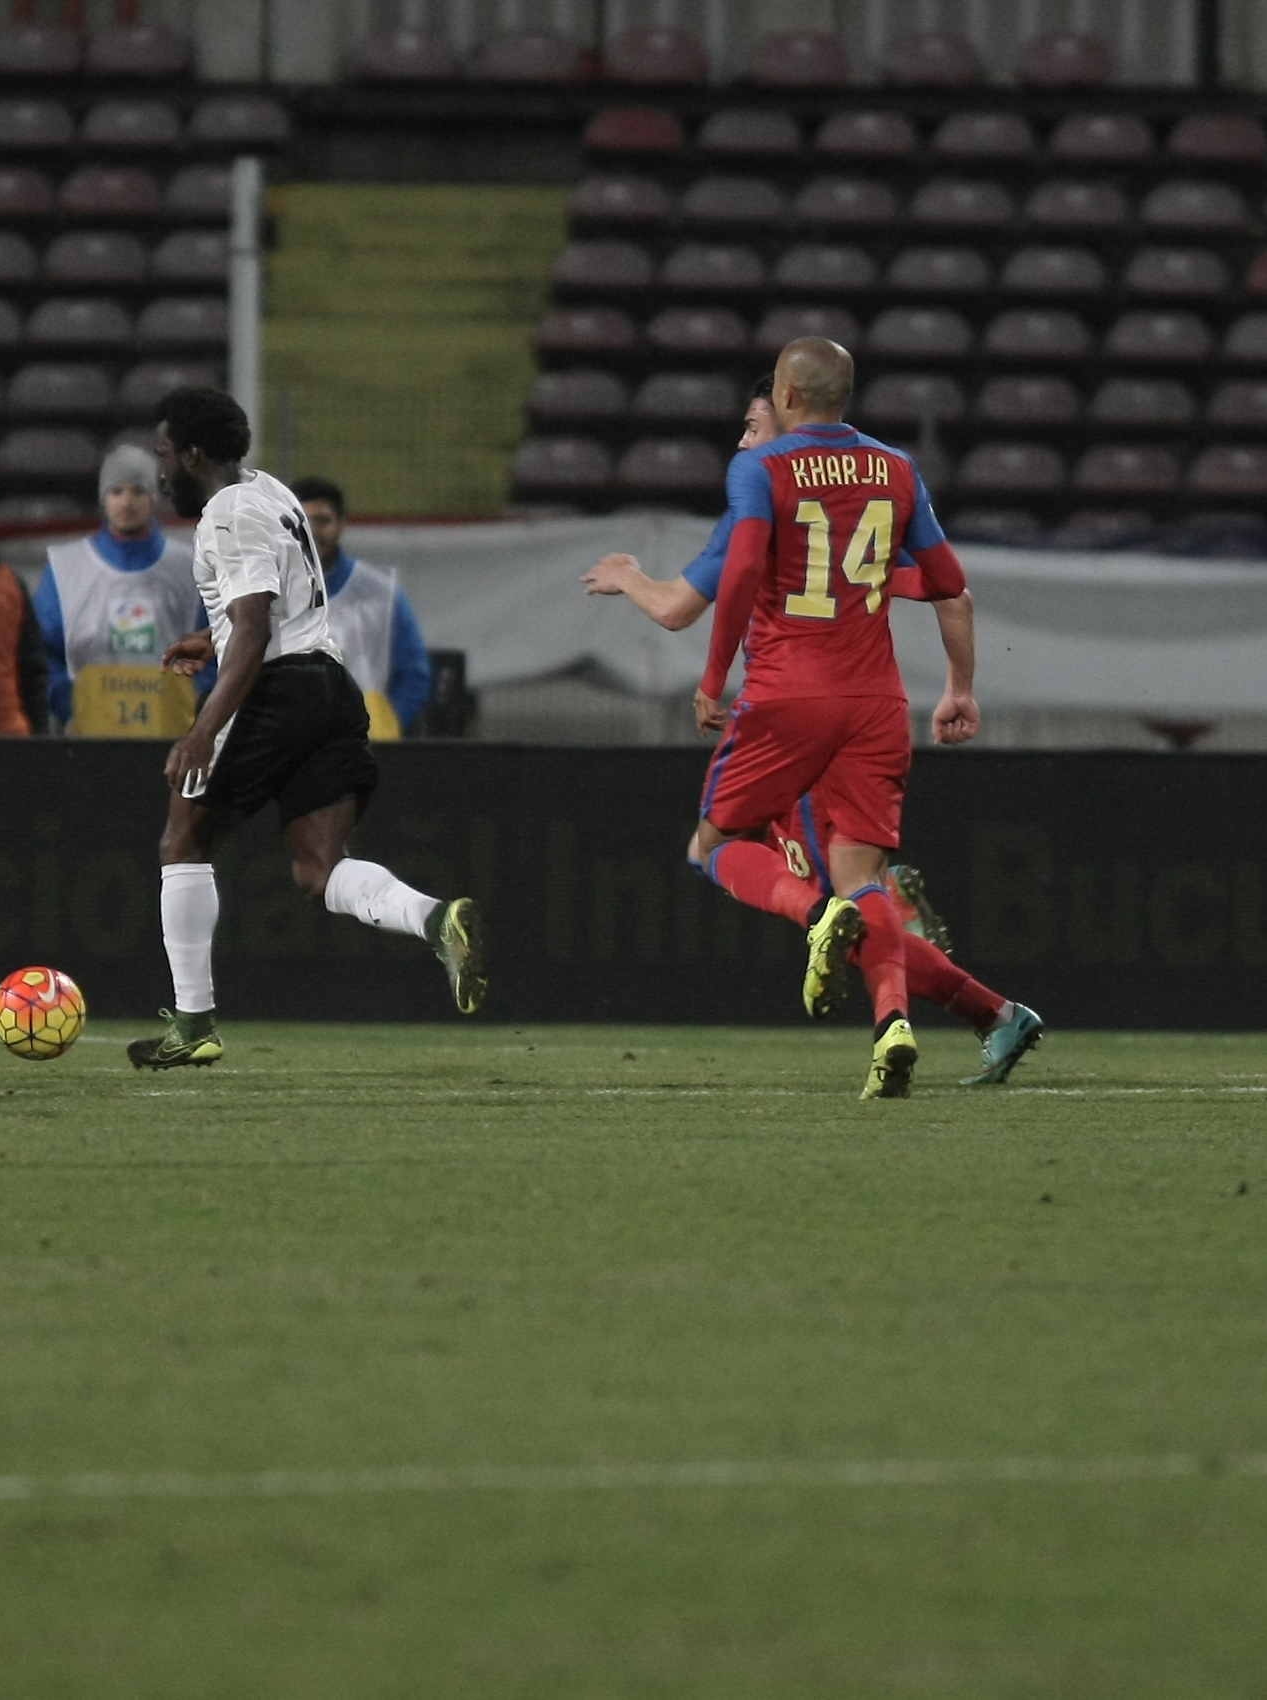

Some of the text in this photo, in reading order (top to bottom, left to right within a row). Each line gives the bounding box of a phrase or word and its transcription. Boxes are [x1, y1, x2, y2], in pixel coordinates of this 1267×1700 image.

[791, 454, 889, 488] KHARJA
[785, 498, 894, 619] 14
[119, 701, 150, 725] 14
